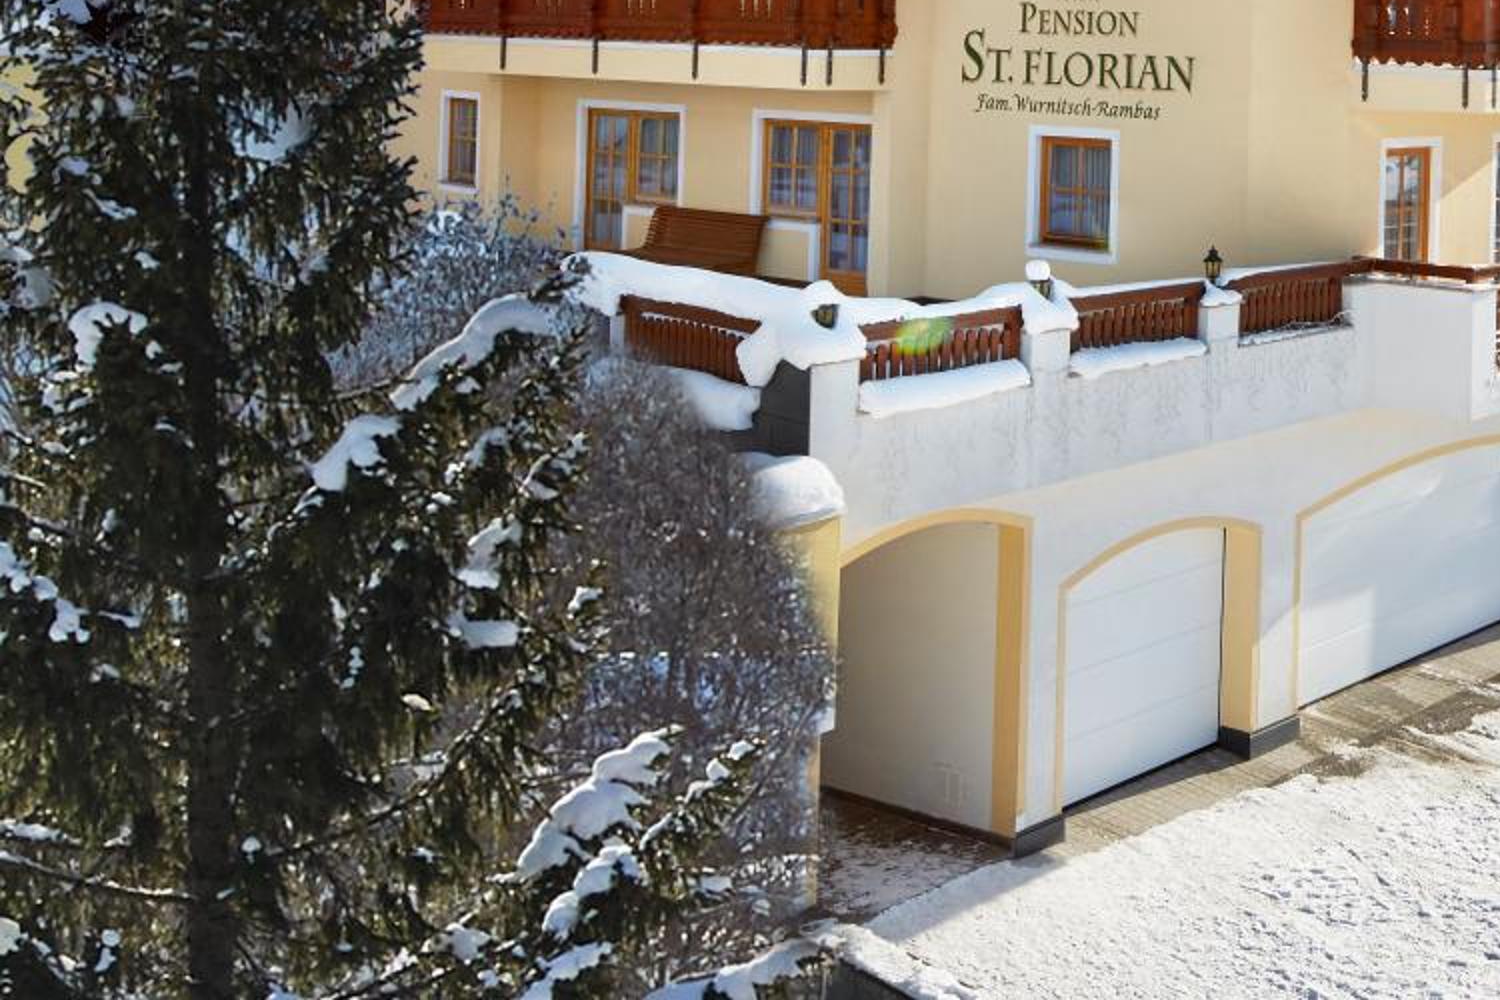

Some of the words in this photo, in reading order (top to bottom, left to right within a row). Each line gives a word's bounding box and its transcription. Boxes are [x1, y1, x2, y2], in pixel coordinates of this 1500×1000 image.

[1019, 1, 1141, 37] PENSION
[961, 28, 1013, 84] ST.
[1022, 48, 1196, 98] FLORIAN
